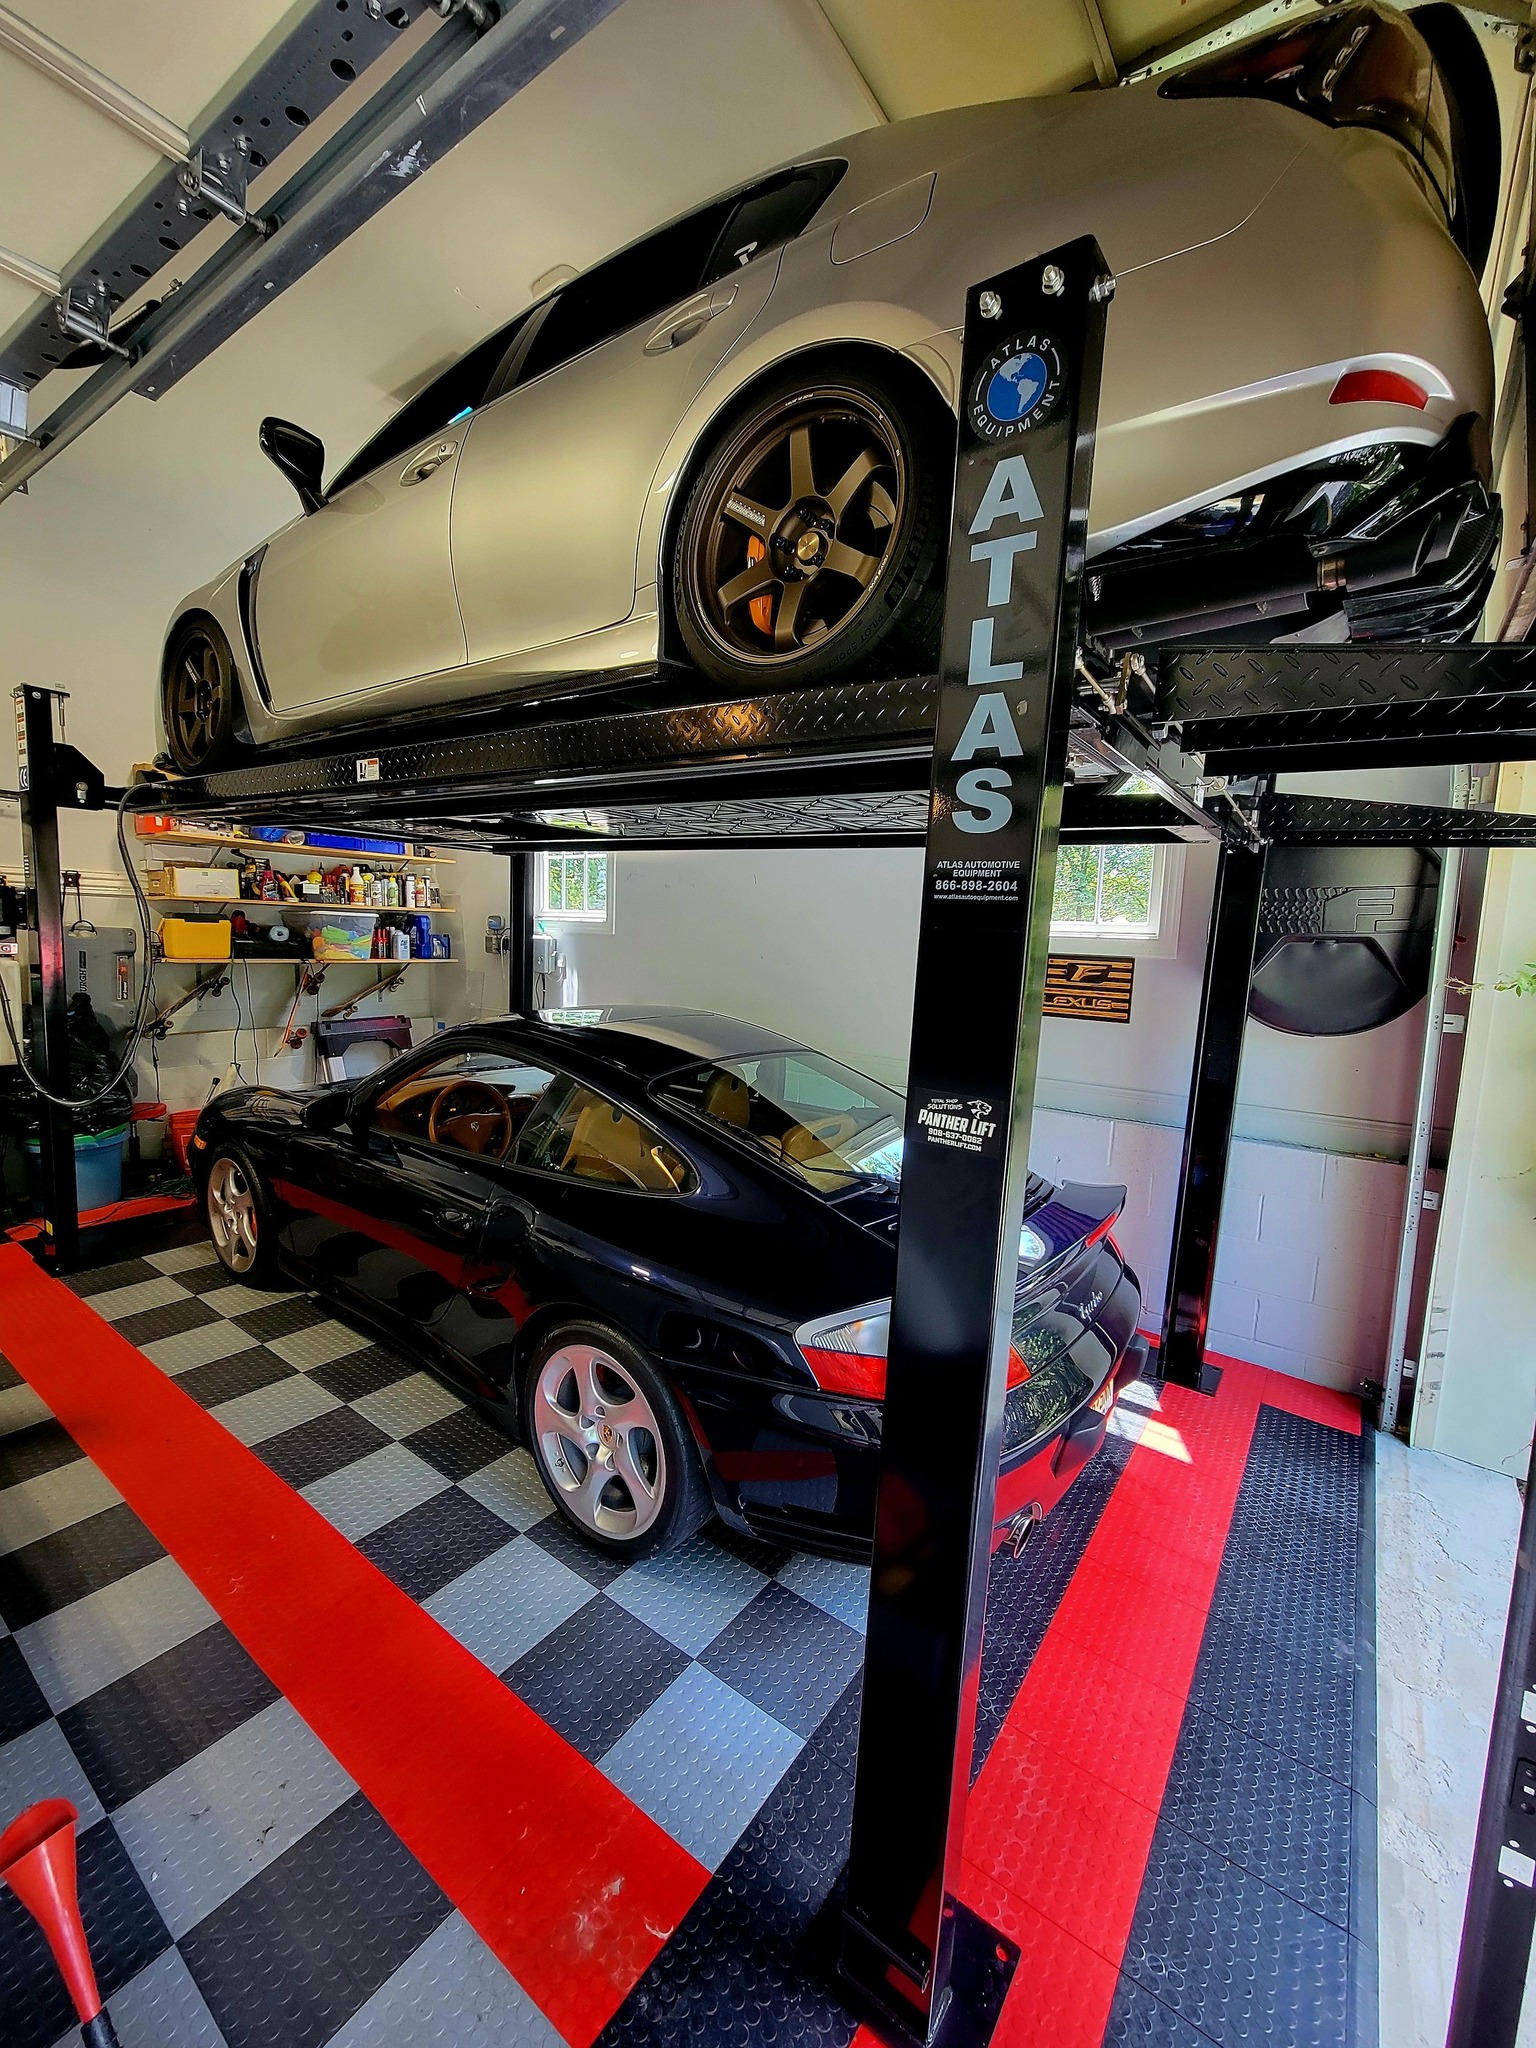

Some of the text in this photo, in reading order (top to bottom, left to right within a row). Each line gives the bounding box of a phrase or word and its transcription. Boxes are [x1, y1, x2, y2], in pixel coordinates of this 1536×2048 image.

[990, 334, 1051, 370] ATLAS
[973, 379, 1062, 438] EQUIPMENT
[825, 613, 884, 668] PILOT SPORT
[952, 455, 1044, 834] ATLAS
[937, 861, 1021, 870] ATLAS AUTOMOTIVE
[952, 869, 1002, 878] EQUIPMENT
[933, 893, 1019, 902] www.atlasautoequipment.com
[935, 880, 1018, 892] 866-898-2604
[926, 1103, 963, 1111] SOLUTIONS
[917, 1108, 997, 1138] PANTHER LIFT
[927, 1135, 982, 1153] PANTHERLIFT.COM
[1077, 1290, 1104, 1323] Turbo
